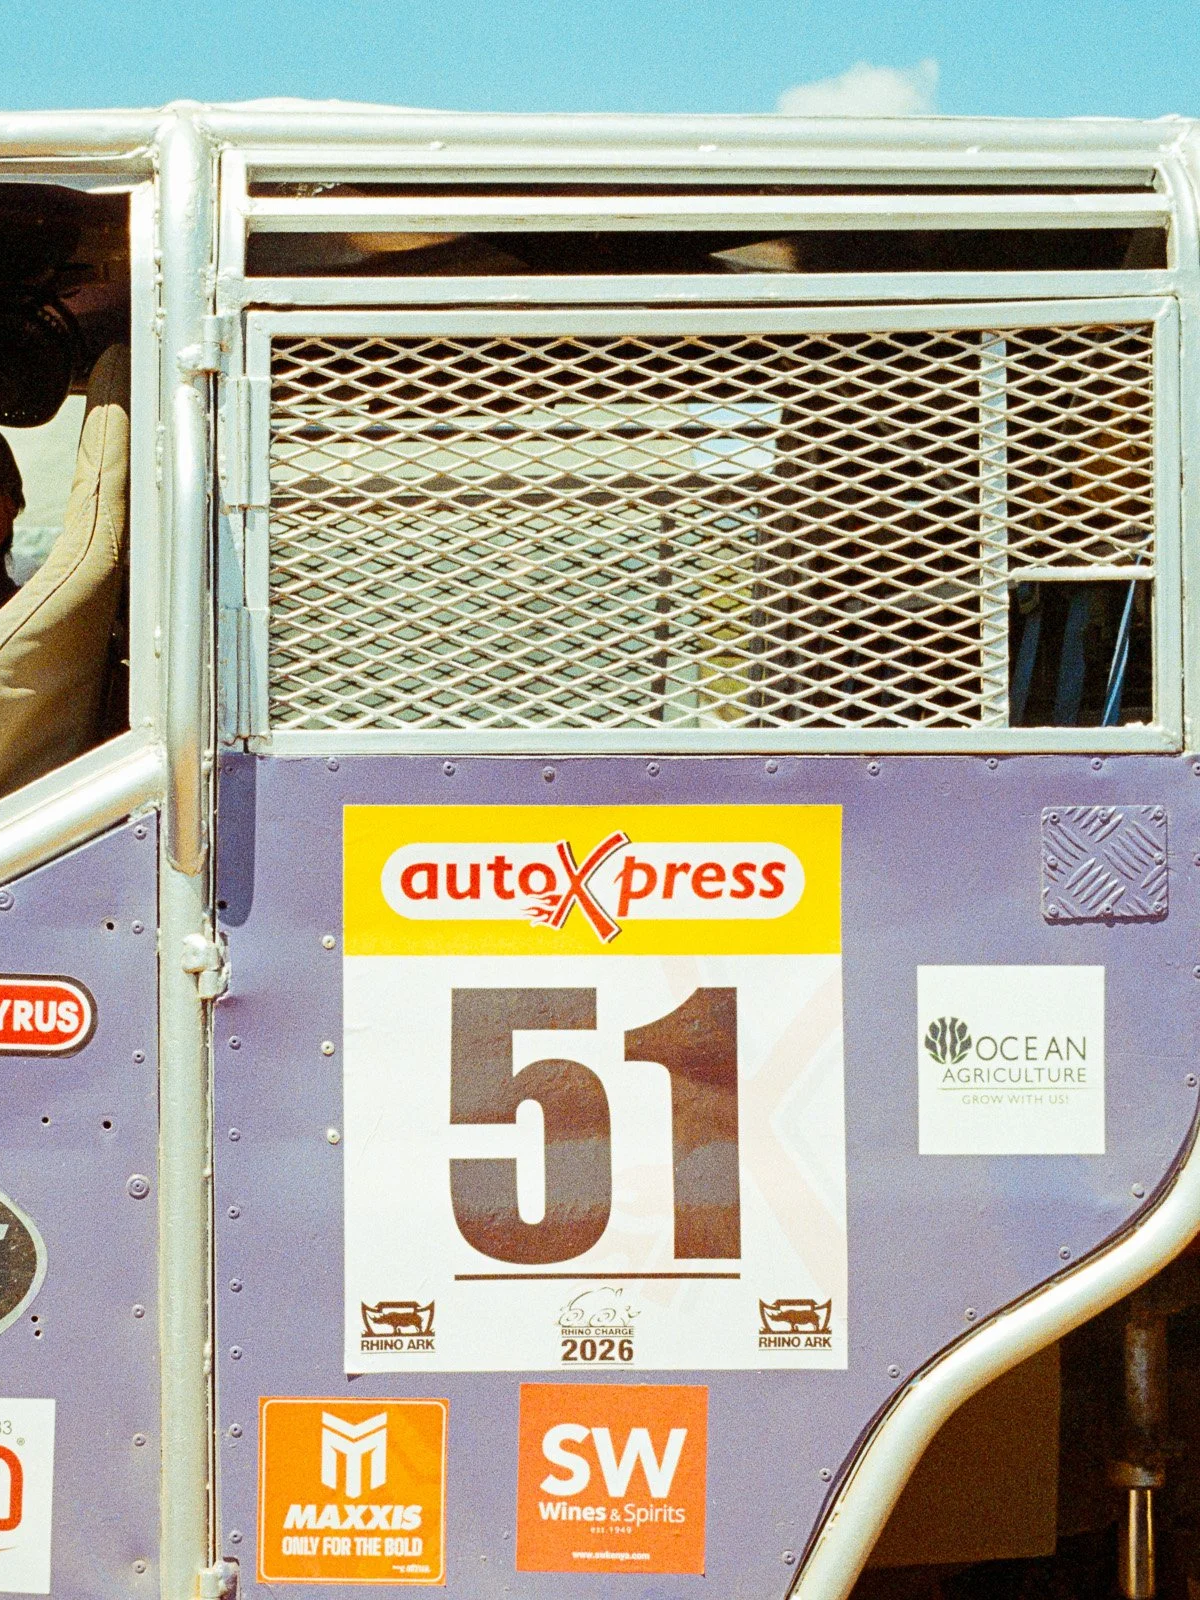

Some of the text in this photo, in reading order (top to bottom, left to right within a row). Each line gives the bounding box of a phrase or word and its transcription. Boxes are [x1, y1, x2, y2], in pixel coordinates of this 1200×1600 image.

[400, 831, 786, 943] autoXpress
[976, 1036, 1087, 1061] OCEAN
[942, 1068, 1088, 1083] AGRICULTURE
[962, 1094, 1070, 1105] GROW WITH US!
[449, 986, 741, 1265] 51
[561, 1328, 634, 1336] RHINO CHARGE
[759, 1336, 832, 1348] RHINO ARK
[361, 1339, 435, 1351] RHINO ARK
[561, 1338, 634, 1362] 2026
[540, 1423, 688, 1499] SW
[283, 1504, 422, 1530] MAXXIS
[538, 1501, 685, 1527] Wines & Spirits
[282, 1536, 424, 1558] ONLY FOR THE BOLD
